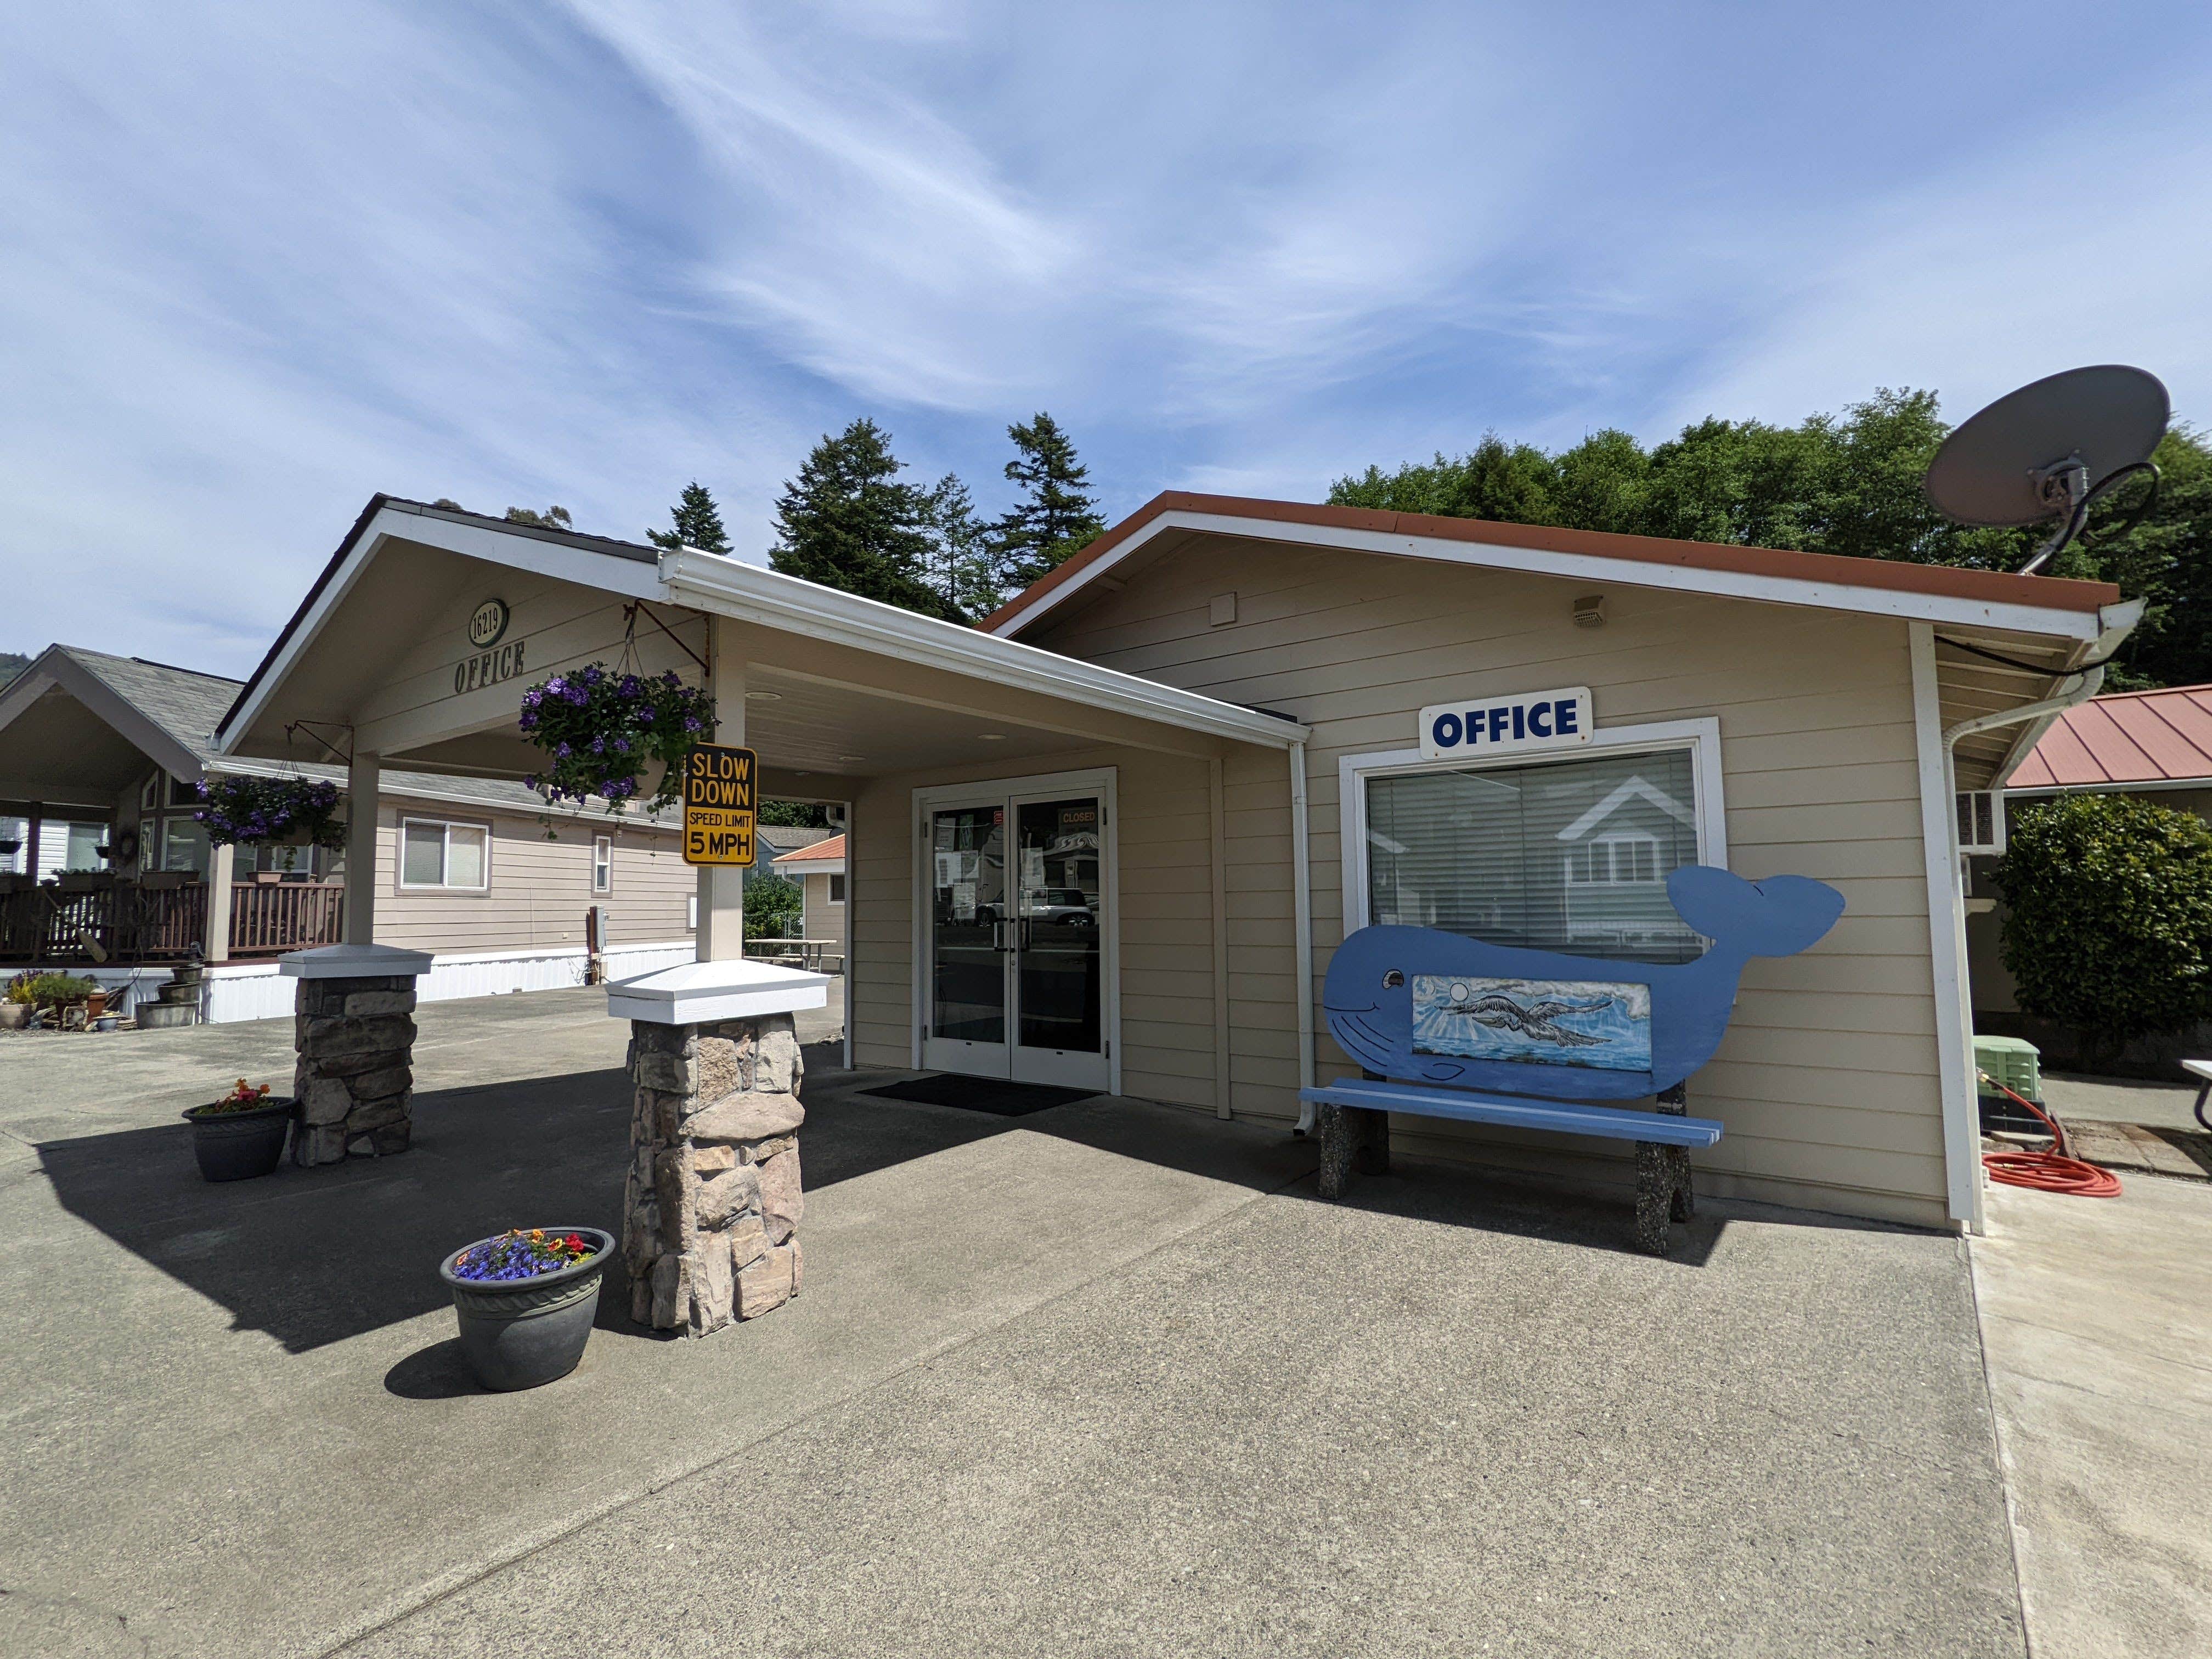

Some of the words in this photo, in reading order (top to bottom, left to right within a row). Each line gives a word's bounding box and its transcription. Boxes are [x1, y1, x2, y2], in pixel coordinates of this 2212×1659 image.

[473, 607, 498, 639] 16219
[455, 641, 525, 693] OFFICE
[1432, 698, 1578, 748] OFFICE
[692, 752, 749, 781] SLOW
[691, 778, 749, 806] DOWN
[689, 812, 722, 826] SPEED
[725, 814, 751, 828] LIMIT
[1063, 812, 1095, 823] CLOSED
[690, 831, 705, 855] 5
[709, 832, 749, 856] MPH
